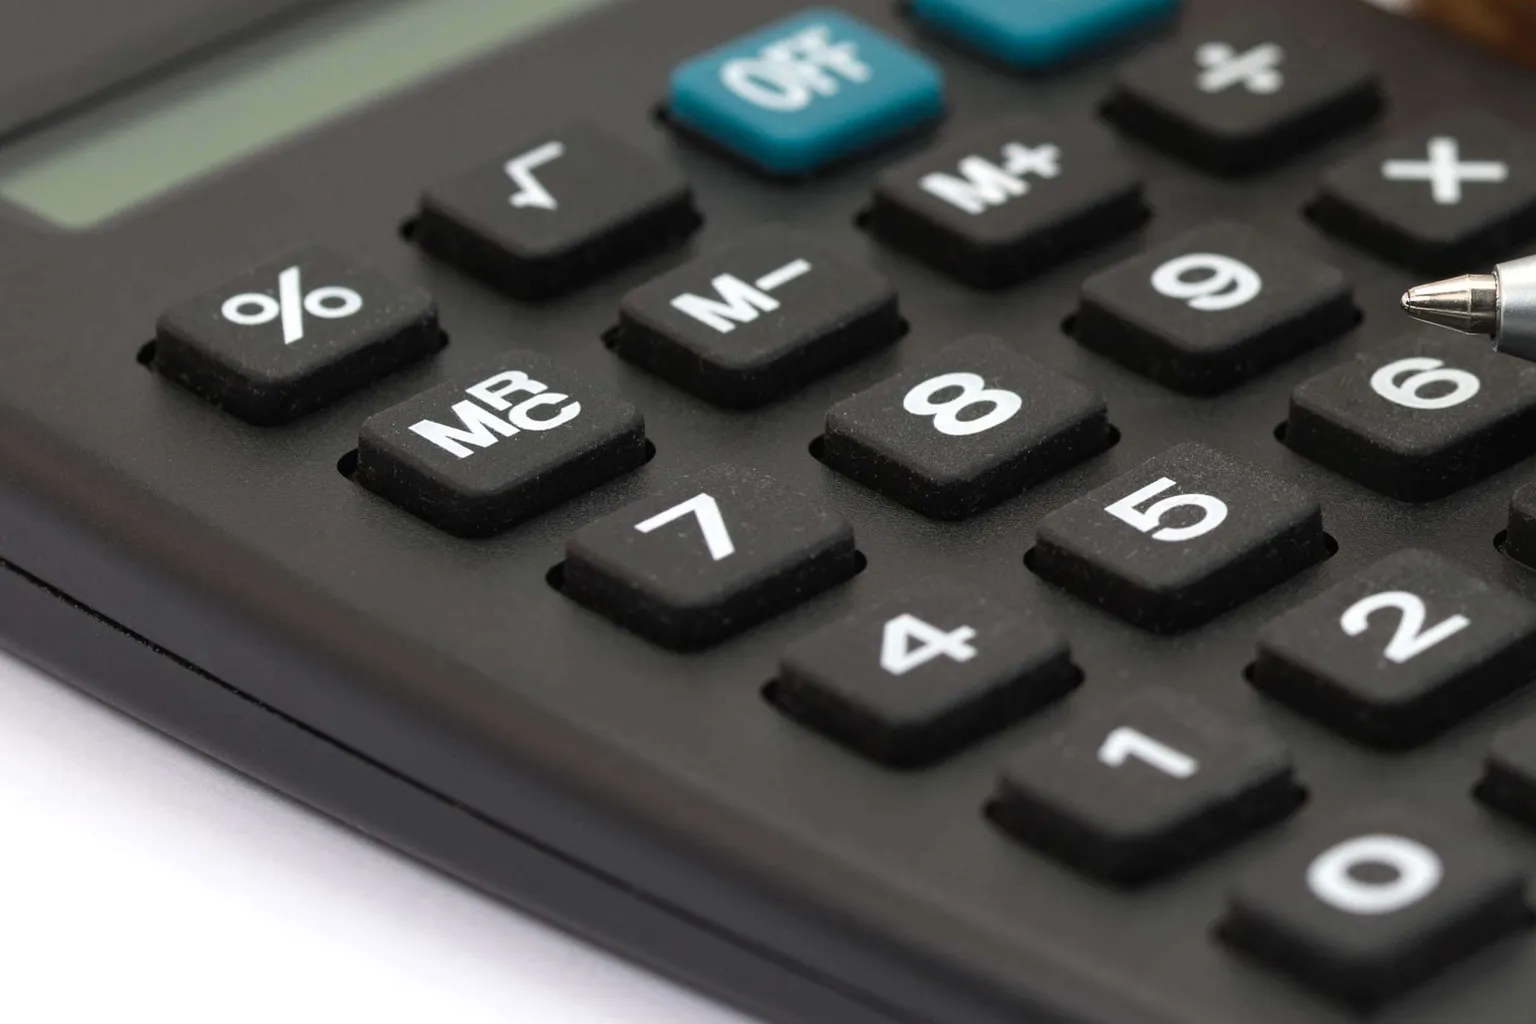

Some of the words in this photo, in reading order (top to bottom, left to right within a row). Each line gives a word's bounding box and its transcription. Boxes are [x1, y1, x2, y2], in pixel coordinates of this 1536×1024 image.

[720, 25, 872, 112] OFF
[920, 141, 1061, 214] M+
[221, 266, 364, 345] %
[1151, 253, 1263, 311] 9
[902, 371, 1024, 436] 8
[1370, 356, 1482, 410] 6
[634, 491, 735, 561] 7
[1103, 475, 1228, 543] 5
[879, 612, 977, 675] 4
[1340, 590, 1470, 664] 2
[1097, 725, 1197, 779] 1
[1307, 835, 1442, 914] 0
